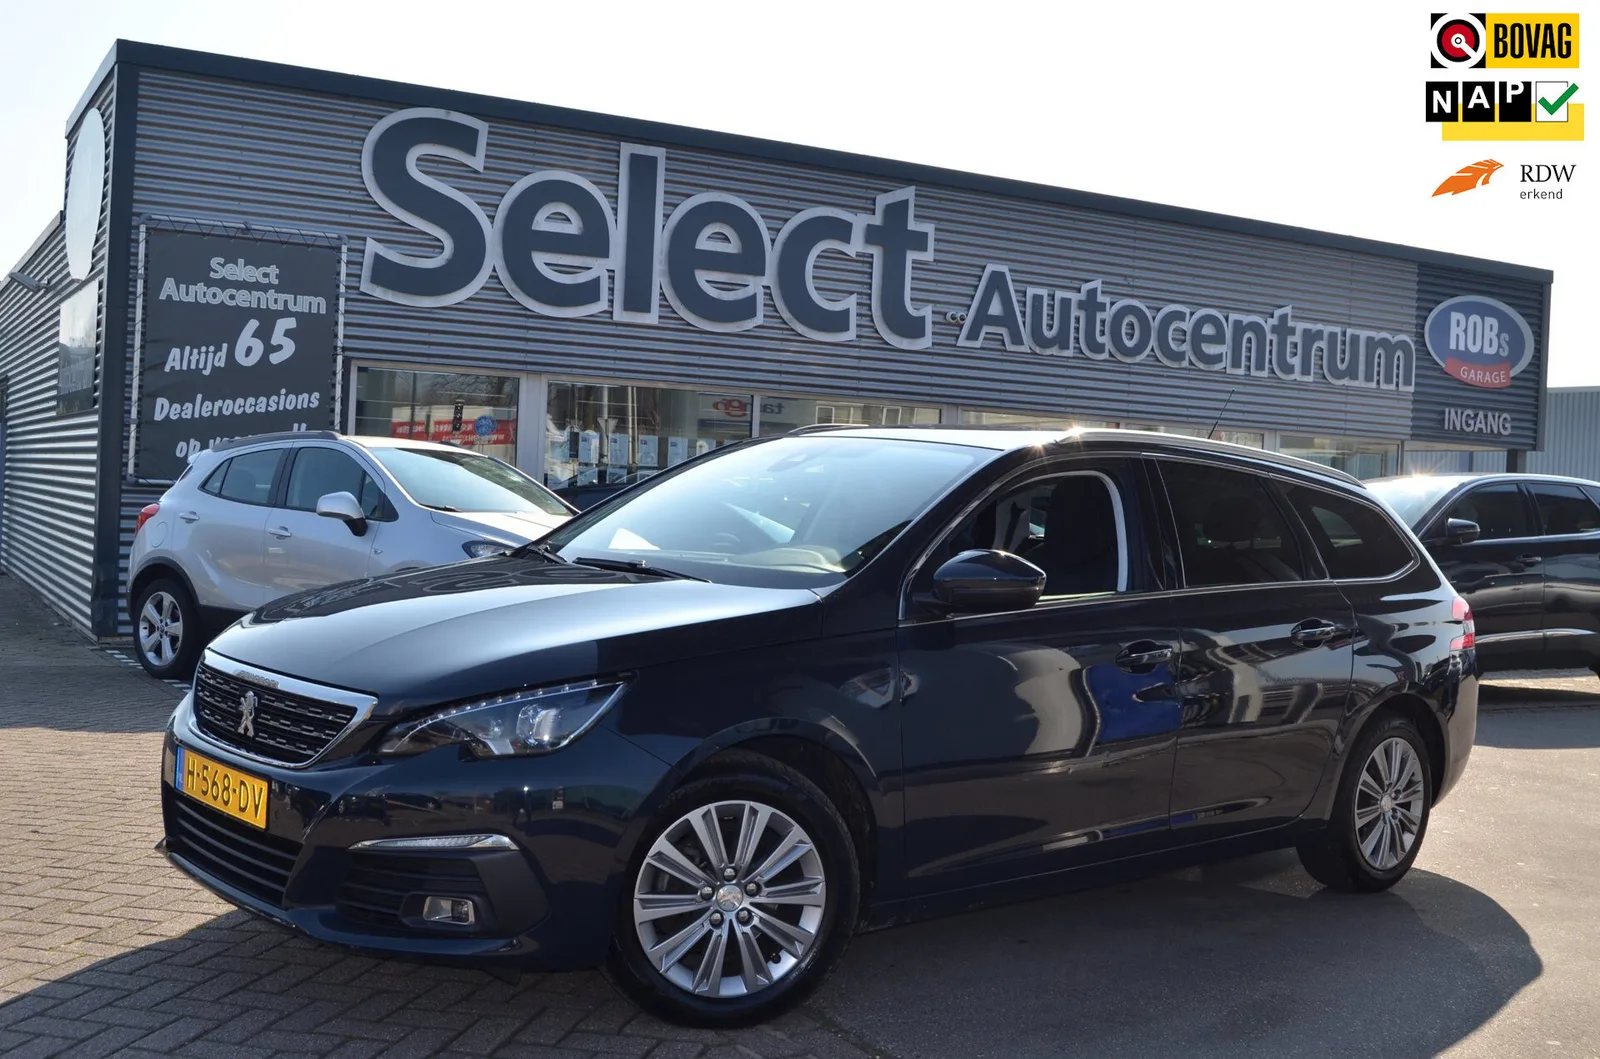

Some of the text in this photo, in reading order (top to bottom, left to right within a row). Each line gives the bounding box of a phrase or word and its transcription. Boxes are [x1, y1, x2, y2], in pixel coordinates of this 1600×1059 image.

[359, 107, 1416, 392] Select Autocentrum
[209, 256, 280, 285] Select
[159, 277, 327, 315] Autocentrum
[164, 317, 297, 375] Altijd 65
[1449, 311, 1510, 357] ROBs
[1460, 365, 1507, 384] GARAGE
[154, 388, 321, 421] Dealeroccasions
[1444, 406, 1512, 436] INGANG
[187, 757, 266, 820] H-568-DV
